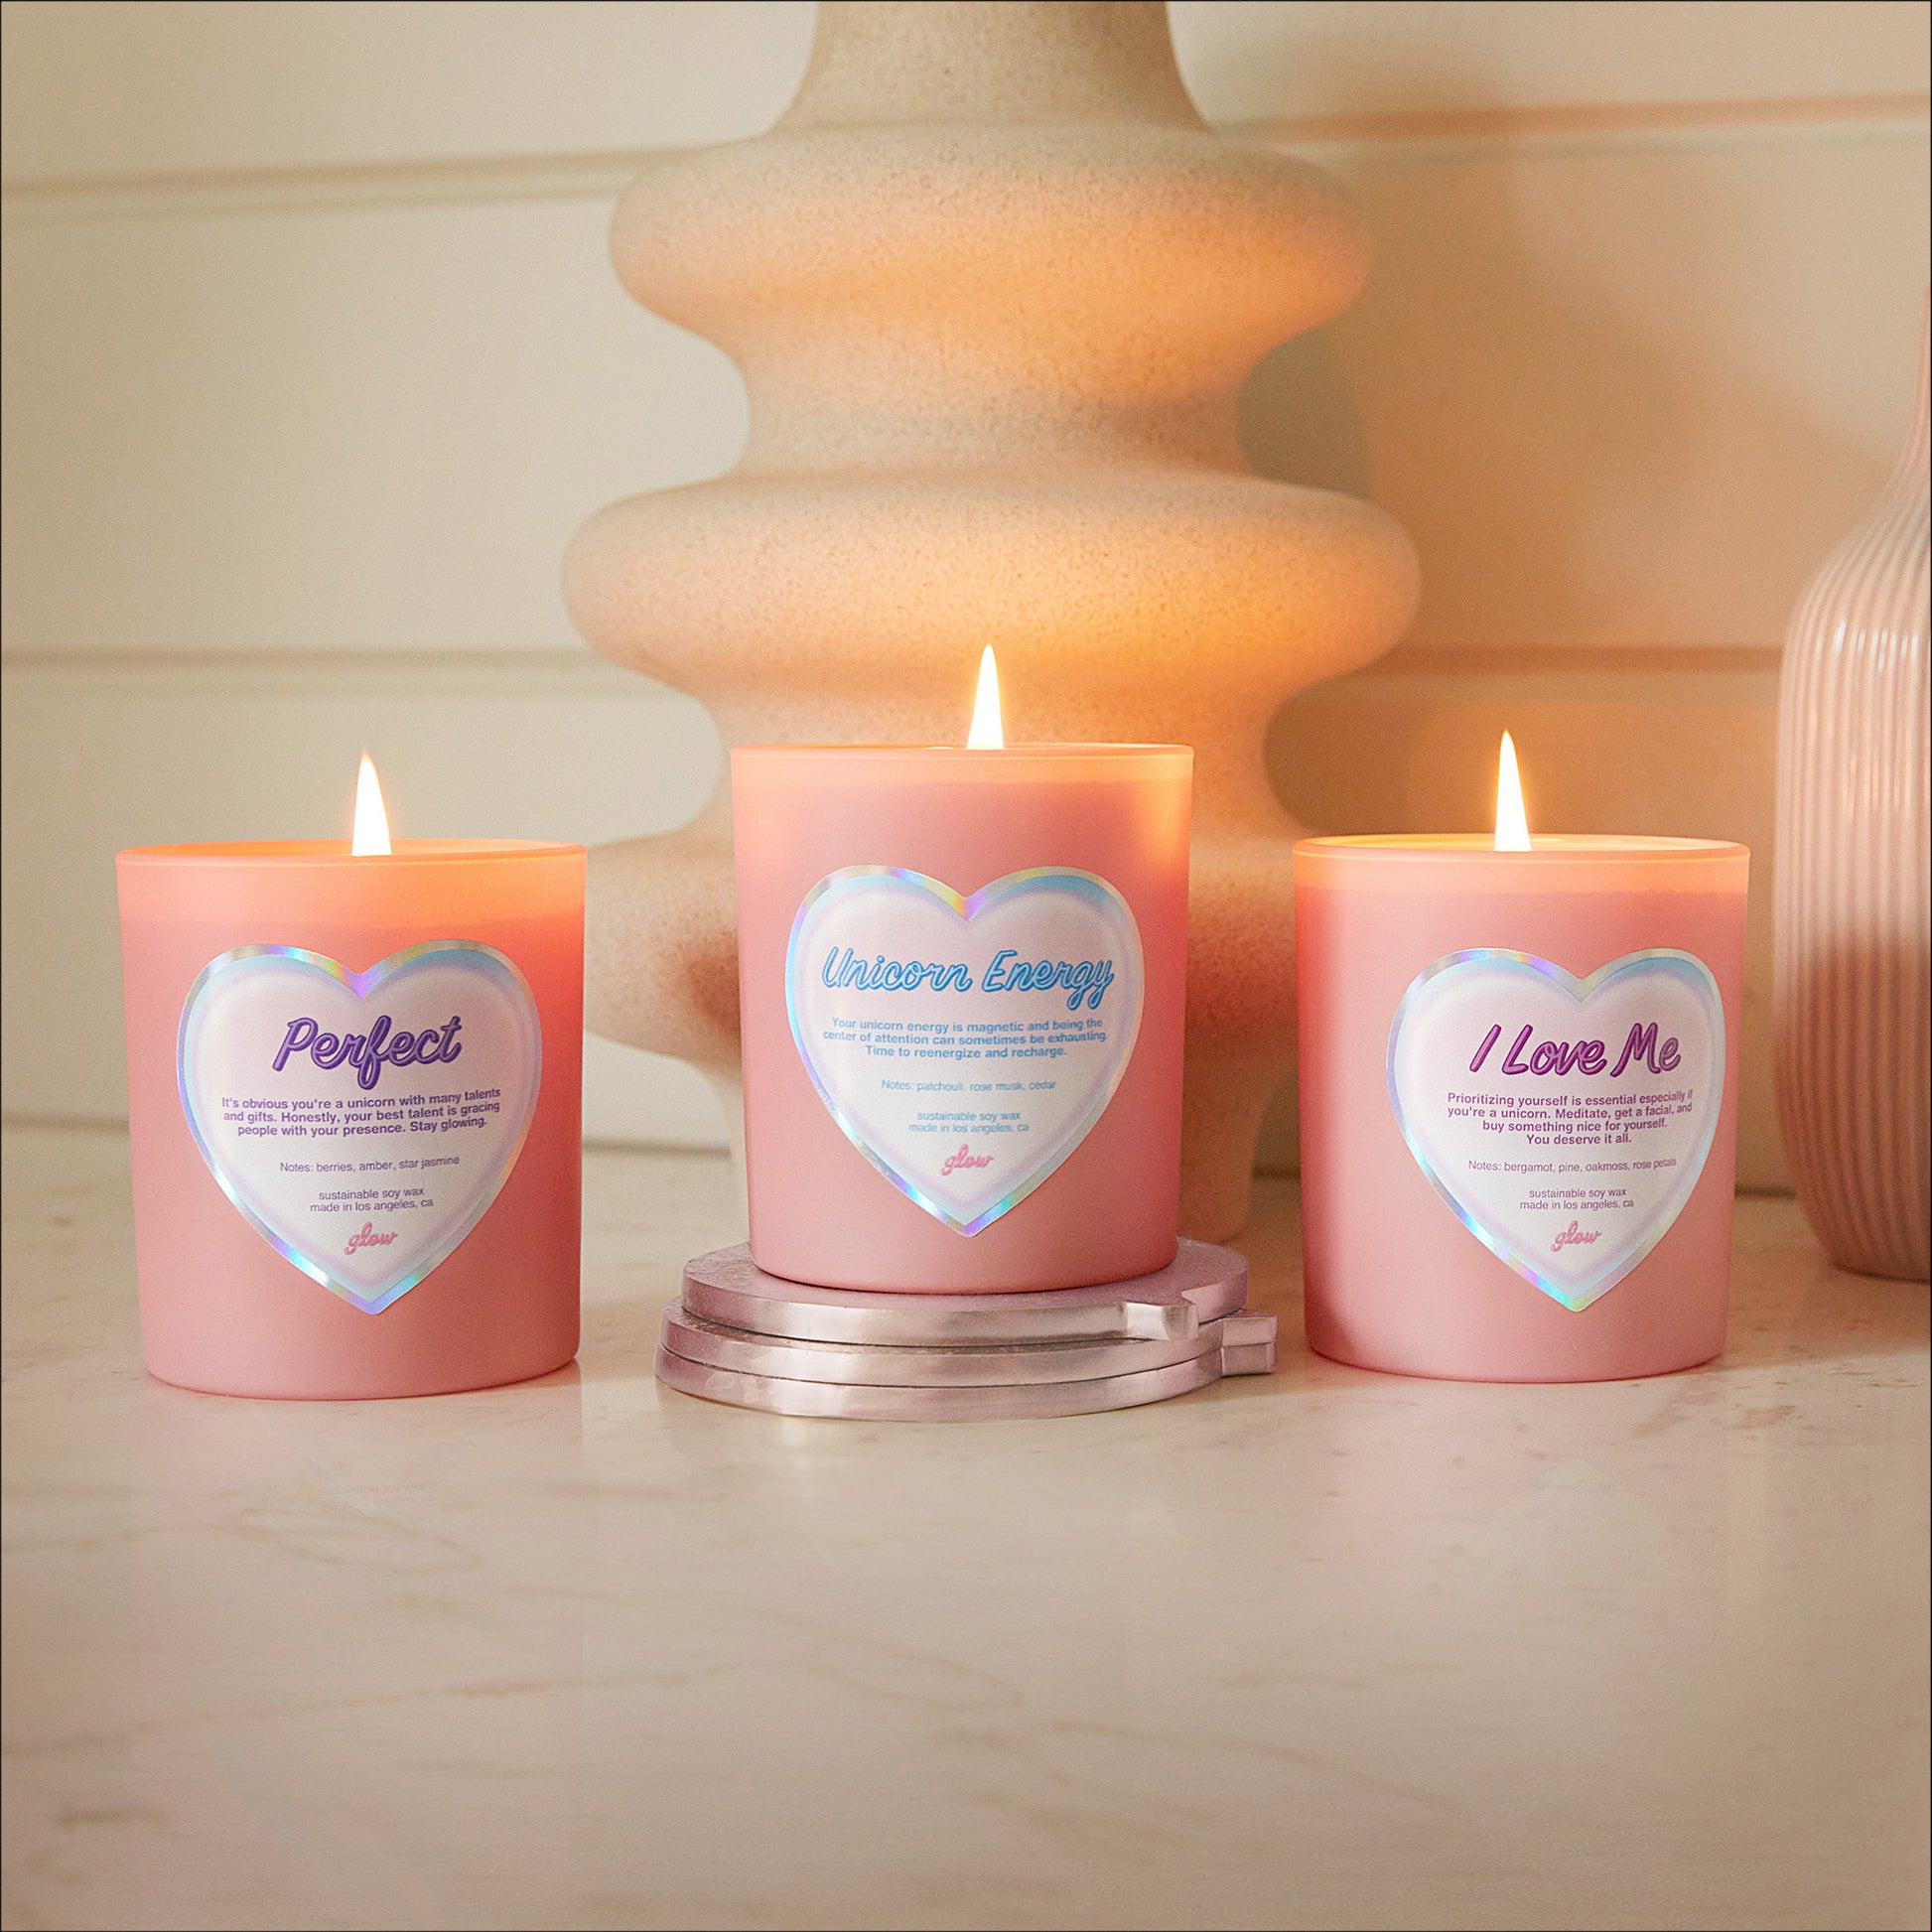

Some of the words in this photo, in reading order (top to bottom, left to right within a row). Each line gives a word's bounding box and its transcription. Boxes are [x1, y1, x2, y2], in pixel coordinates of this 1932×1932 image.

[822, 946, 973, 993] Unicorn
[981, 949, 1115, 1012] Energy
[832, 1017, 857, 1028] Your
[860, 1019, 903, 1031] unicorn
[906, 1023, 949, 1035] energy
[953, 1022, 963, 1033] is
[967, 1021, 1025, 1035] magnetic
[1028, 1021, 1049, 1031] and
[1052, 1020, 1083, 1032] being
[1086, 1018, 1103, 1028] the
[823, 1031, 857, 1041] center
[860, 1033, 871, 1042] of
[875, 1034, 929, 1044] attention
[932, 1035, 954, 1044] can
[958, 1035, 1027, 1045] sometimes
[1030, 1035, 1044, 1043] be
[273, 1015, 463, 1090] Perfect
[866, 1044, 895, 1056] Time
[898, 1046, 910, 1057] to
[913, 1047, 981, 1060] reenergize
[985, 1047, 1008, 1058] and
[1469, 1024, 1502, 1073] I
[1501, 1024, 1607, 1076] Love
[1609, 1022, 1682, 1078] Me
[881, 1079, 913, 1090] Notes:
[1029, 1080, 1056, 1090] cedar
[222, 1097, 239, 1108] It's
[242, 1098, 288, 1109] obvious
[291, 1099, 331, 1111] you're
[347, 1097, 395, 1108] unicorn
[399, 1094, 425, 1106] with
[429, 1093, 462, 1104] many
[465, 1088, 500, 1101] talents
[1448, 1092, 1515, 1108] Prioritizing
[1518, 1095, 1569, 1108] yourself
[1572, 1095, 1582, 1106] is
[1586, 1093, 1636, 1106] essential
[1639, 1090, 1686, 1105] especially
[1687, 1089, 1693, 1099] if
[223, 1112, 244, 1121] and
[247, 1112, 277, 1124] gifts.
[281, 1112, 341, 1125] Honestly,
[345, 1113, 372, 1124] your
[376, 1110, 404, 1120] best
[408, 1108, 444, 1119] talent
[448, 1105, 457, 1115] is
[460, 1101, 500, 1117] gracing
[917, 1111, 977, 1121] sustainable
[979, 1112, 997, 1123] soy
[1448, 1106, 1485, 1118] you're
[1489, 1109, 1497, 1118] a
[1501, 1108, 1551, 1119] unicorn.
[1555, 1108, 1611, 1119] Meditate,
[1614, 1108, 1632, 1120] get
[1645, 1104, 1674, 1116] facial,
[1677, 1102, 1693, 1113] and
[238, 1126, 278, 1137] people
[281, 1125, 307, 1136] with
[311, 1127, 339, 1138] your
[343, 1124, 406, 1137] presence.
[410, 1121, 438, 1133] Stay
[441, 1116, 486, 1132] glowing.
[908, 1123, 937, 1132] made
[940, 1123, 950, 1132] in
[952, 1123, 968, 1133] los
[970, 1123, 1014, 1135] angeles,
[1017, 1123, 1030, 1132] ca
[1482, 1120, 1504, 1133] buy
[1508, 1121, 1573, 1134] something
[1577, 1121, 1601, 1132] nice
[1605, 1120, 1621, 1131] for
[1624, 1117, 1668, 1133] yourself.
[1526, 1134, 1550, 1145] You
[1554, 1135, 1601, 1145] deserve
[1604, 1133, 1612, 1144] it
[1615, 1133, 1632, 1144] all.
[280, 1162, 314, 1173] Notes:
[317, 1163, 356, 1173] berries,
[358, 1161, 396, 1172] amber,
[399, 1159, 419, 1170] star
[420, 1156, 460, 1171] jasmine
[939, 1144, 995, 1176] glow
[1468, 1160, 1501, 1172] Notes:
[1504, 1162, 1556, 1174] bergamot,
[1558, 1162, 1583, 1173] pine,
[1586, 1160, 1630, 1172] oakmoss,
[1632, 1160, 1652, 1170] rose
[1653, 1158, 1677, 1171] petals
[319, 1189, 379, 1200] sustainable
[382, 1189, 400, 1199] soy
[403, 1187, 425, 1197] wax
[1529, 1188, 1586, 1198] sustainable
[1588, 1189, 1605, 1199] soy
[310, 1202, 340, 1212] made
[343, 1202, 351, 1211] in
[355, 1201, 370, 1211] los
[373, 1200, 418, 1212] angeles,
[421, 1198, 434, 1208] ca
[1519, 1200, 1549, 1210] made
[1552, 1200, 1561, 1209] in
[1563, 1200, 1578, 1210] los
[1581, 1200, 1620, 1211] angeles,
[1623, 1199, 1634, 1208] ca
[344, 1221, 398, 1255] glow
[1551, 1220, 1602, 1253] glow
